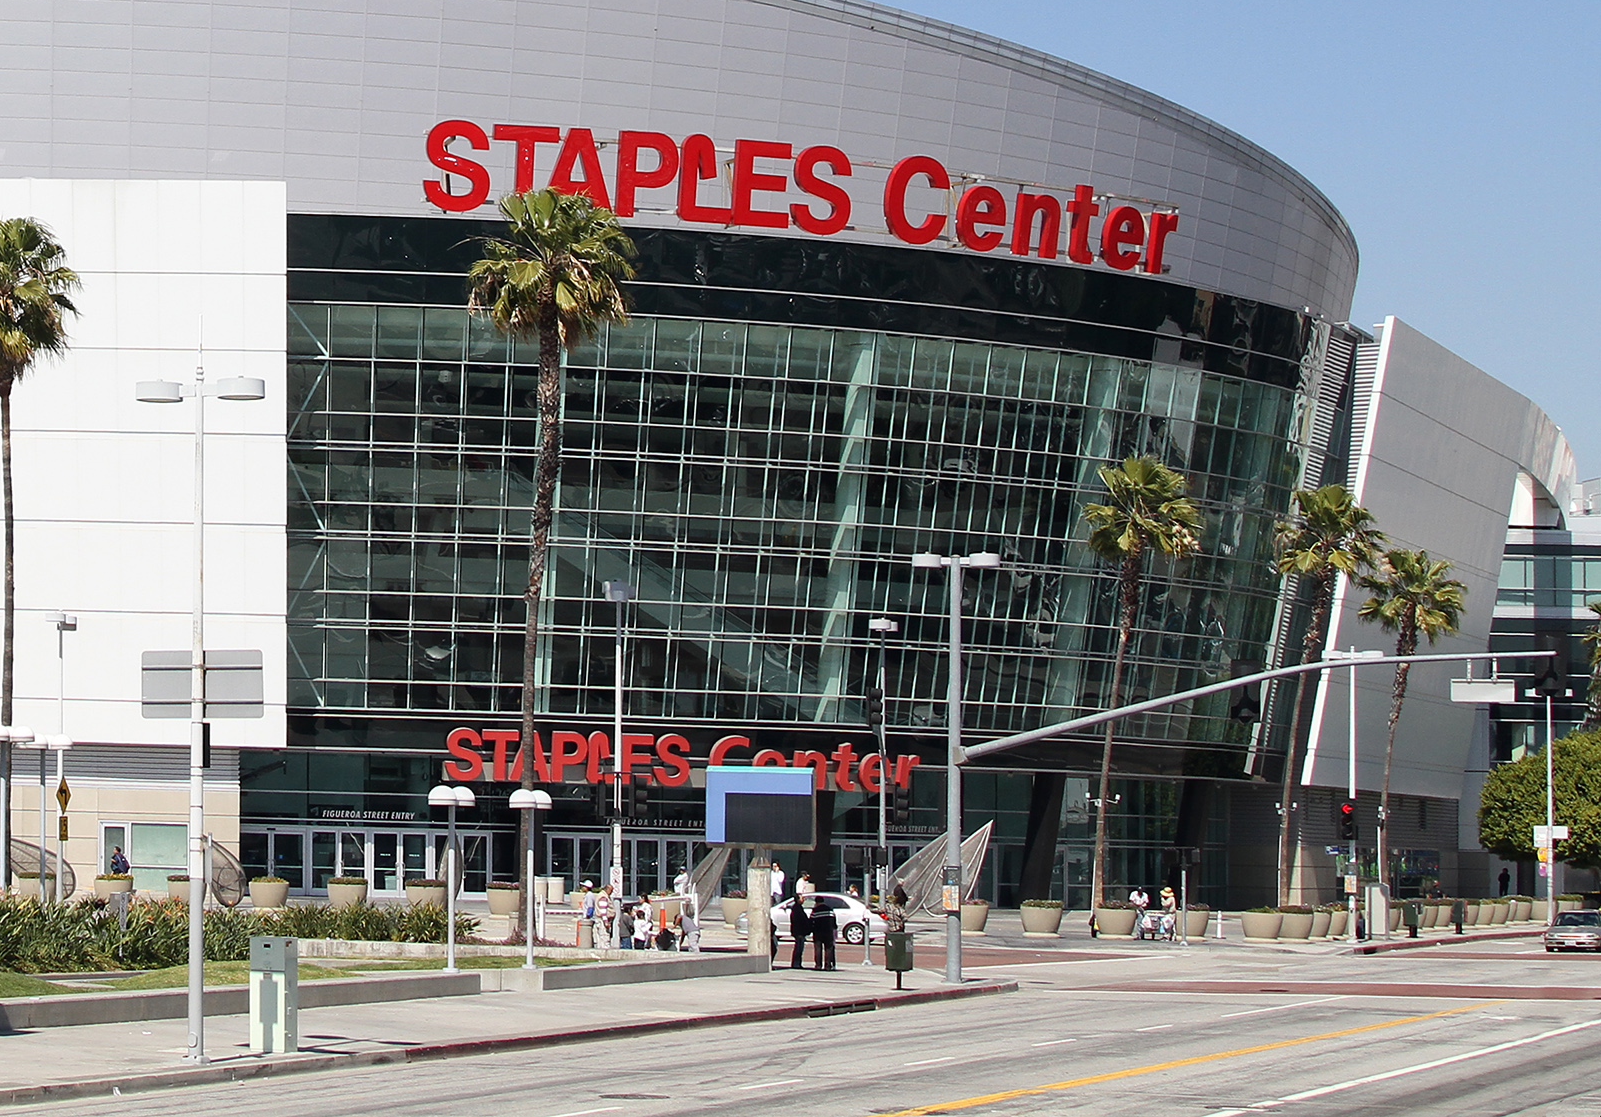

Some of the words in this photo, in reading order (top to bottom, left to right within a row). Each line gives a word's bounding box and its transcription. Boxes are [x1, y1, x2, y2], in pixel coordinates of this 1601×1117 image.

[423, 119, 853, 235] STAPLES
[883, 155, 1178, 274] Center
[444, 727, 691, 788] STAPLES
[322, 809, 361, 819] FIGUEROA
[362, 810, 390, 820] STREET
[390, 812, 416, 821] ENTRY
[653, 819, 683, 827] STREET
[688, 819, 707, 828] ENT
